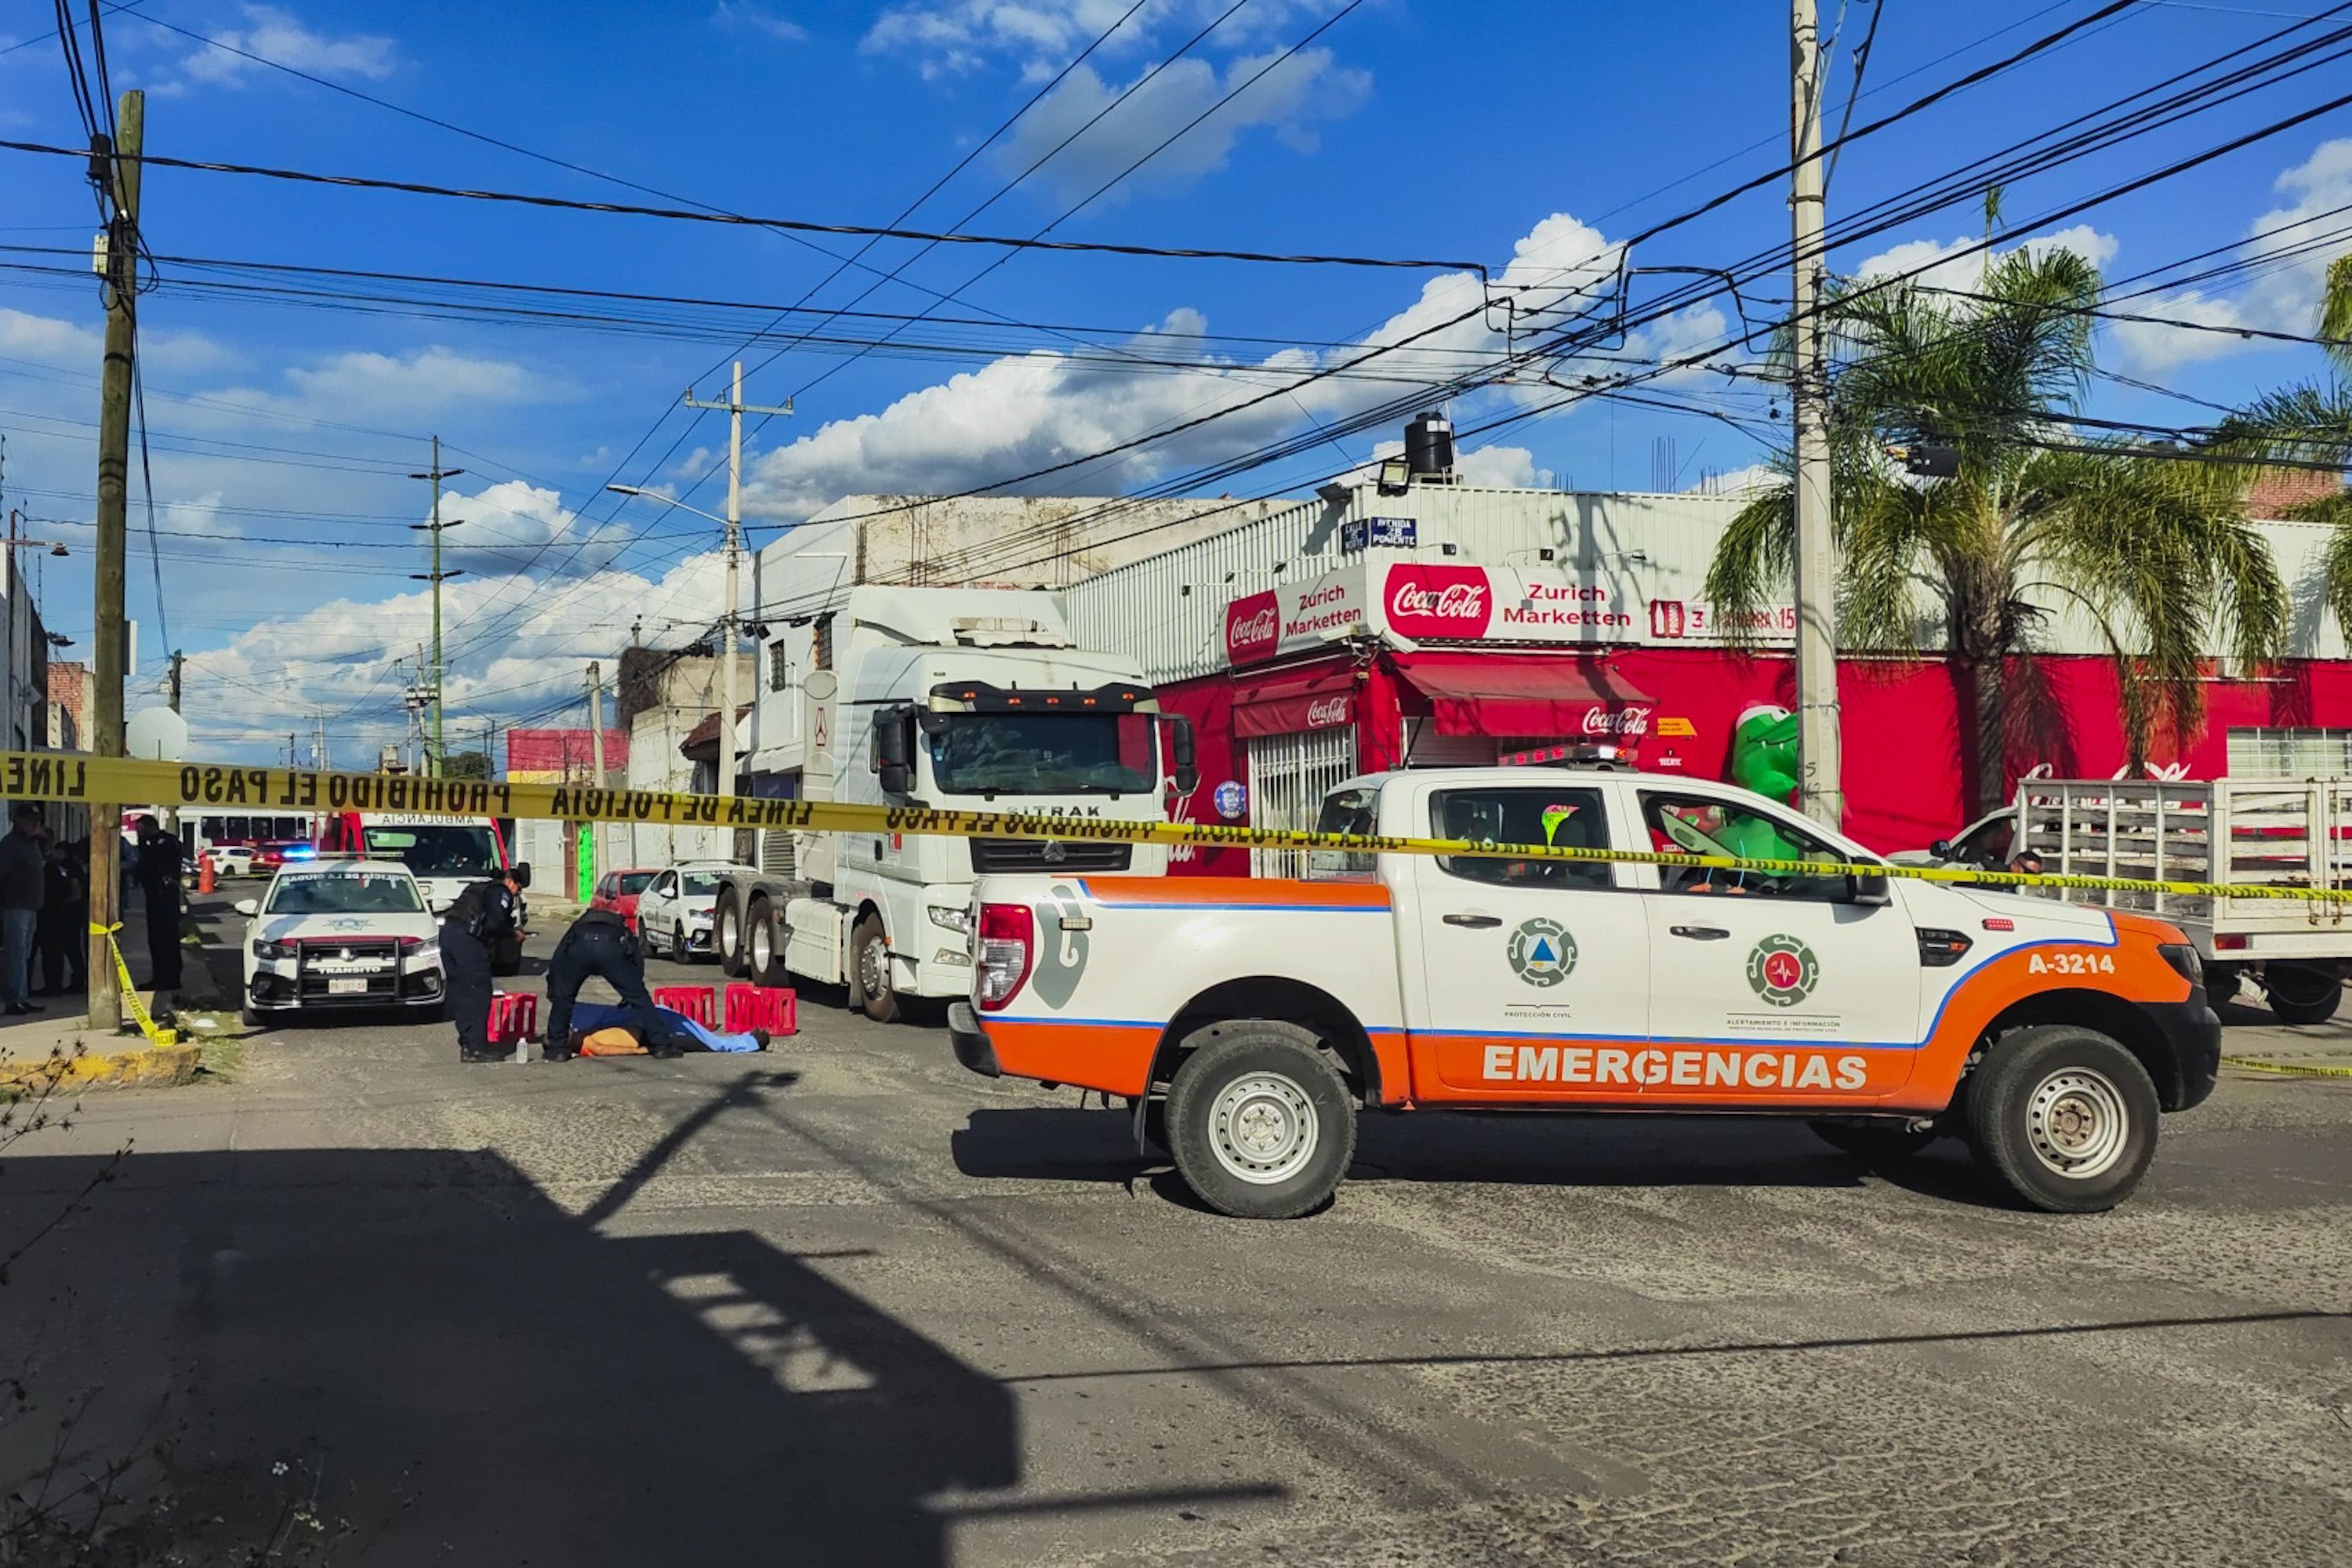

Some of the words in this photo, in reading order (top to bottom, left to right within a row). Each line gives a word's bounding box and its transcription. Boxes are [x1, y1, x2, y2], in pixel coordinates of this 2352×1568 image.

[1377, 519, 1411, 529] AVENIDA
[1373, 535, 1415, 545] PONIENTE
[1299, 585, 1345, 611] Zurich
[1393, 582, 1487, 619] Coca-Cola
[1529, 583, 1605, 601] Zurich
[1286, 608, 1361, 637] Marketten
[1504, 608, 1632, 626] Marketten
[1668, 602, 1679, 634] PROMO
[2029, 953, 2114, 974] A-3214
[1483, 1046, 1867, 1090] EMERGENCIAS
